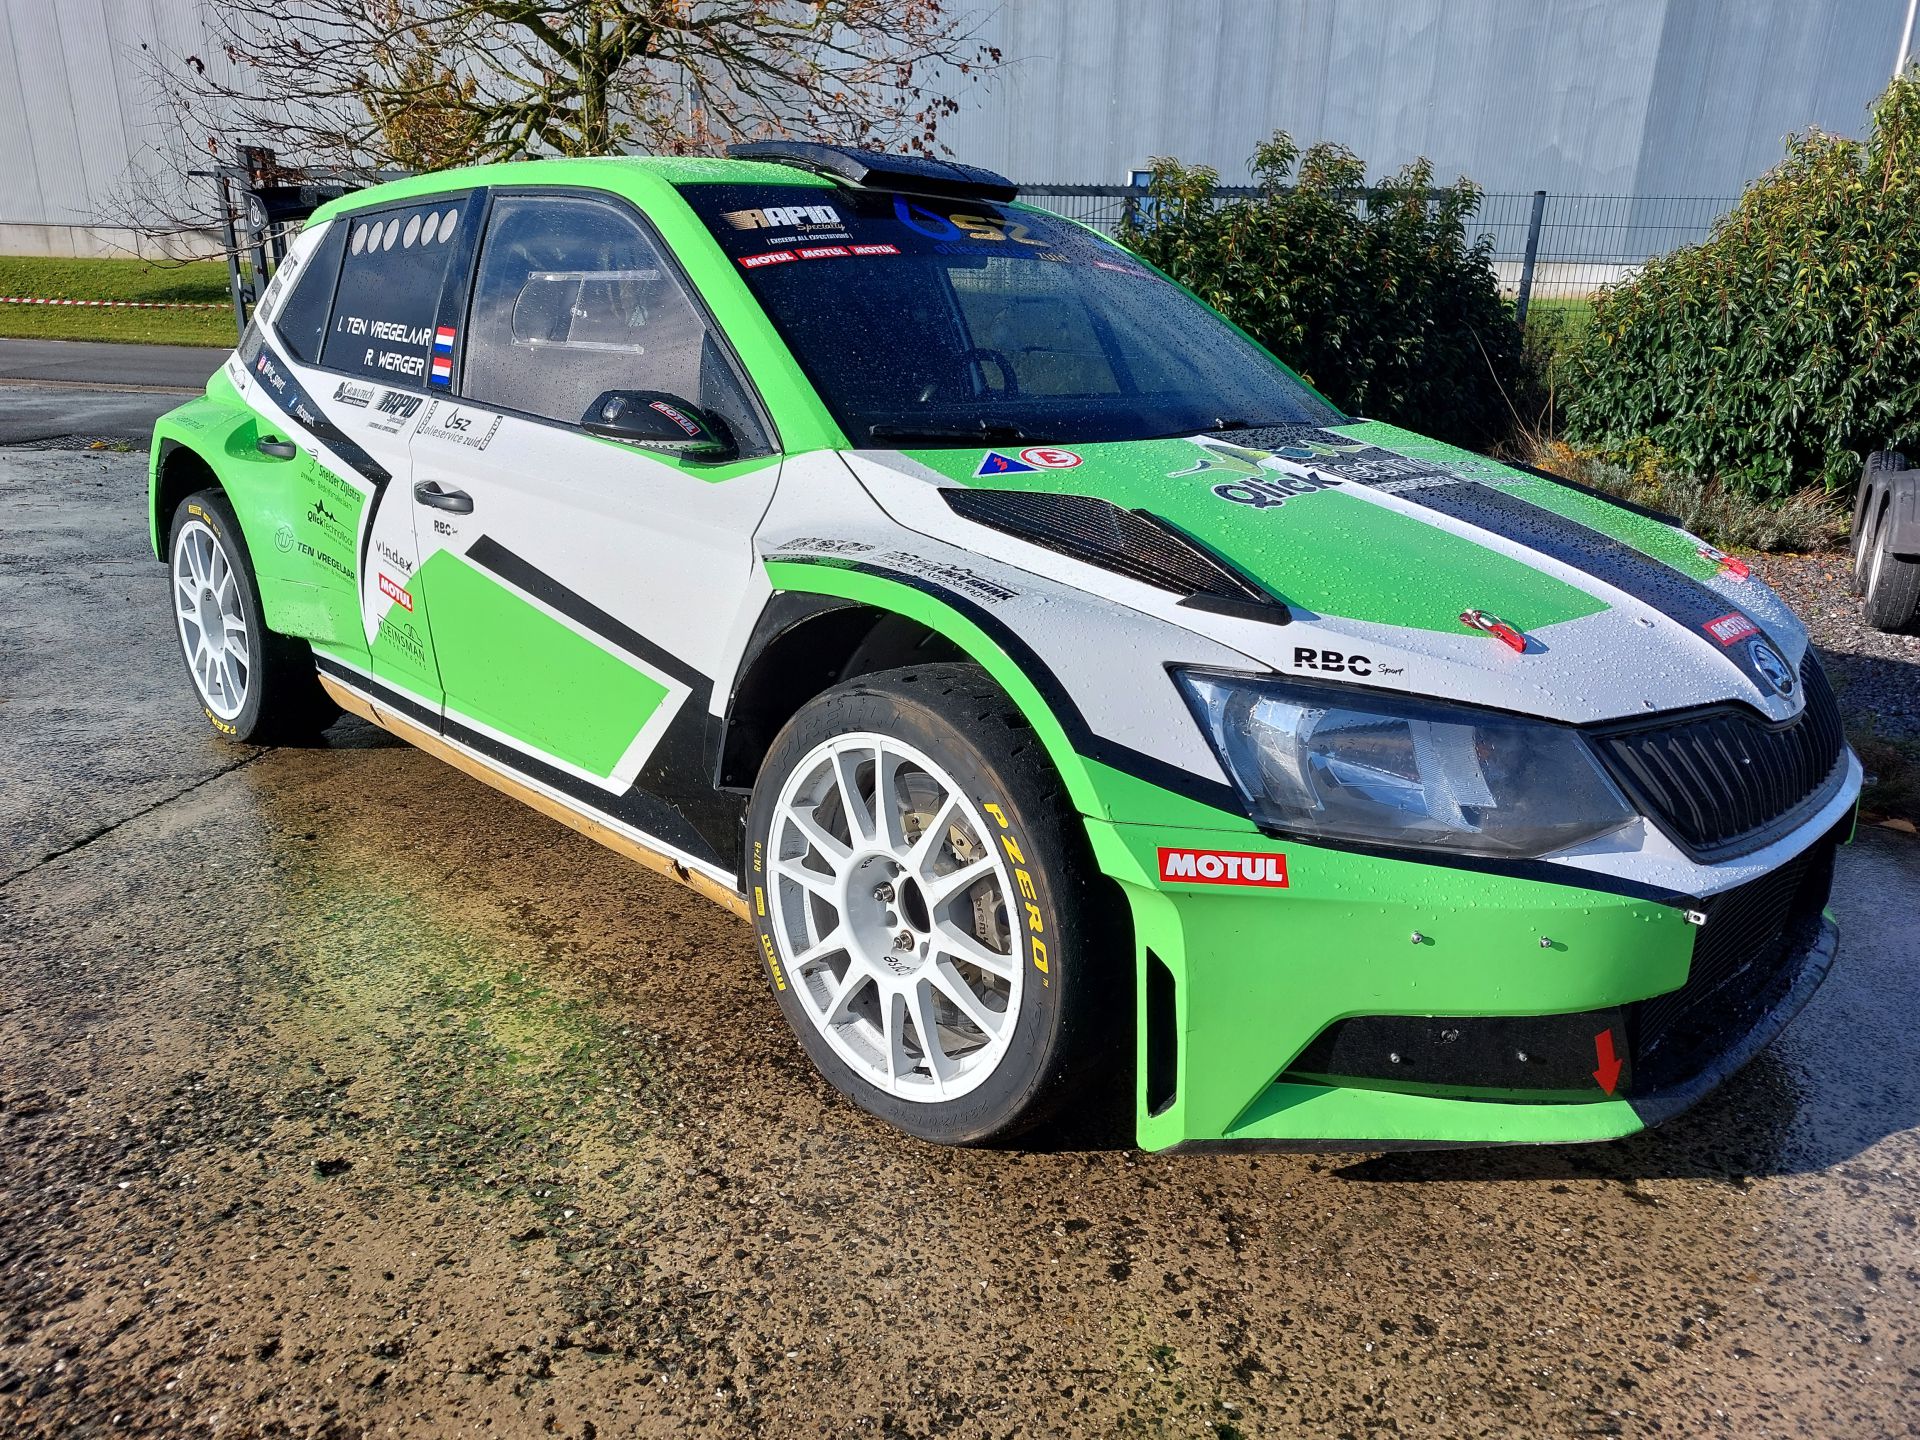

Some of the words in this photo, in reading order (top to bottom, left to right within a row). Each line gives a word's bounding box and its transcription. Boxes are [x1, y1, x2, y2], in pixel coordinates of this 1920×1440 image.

[722, 206, 841, 230] RAPID
[796, 222, 846, 233] Specialty
[746, 253, 794, 267] MOTUL
[801, 247, 847, 258] MOTUL
[854, 245, 897, 255] MOTUL
[347, 317, 368, 335] TEN
[370, 319, 432, 346] VREGELAAR
[364, 349, 373, 366] R.
[378, 351, 425, 377] WERGER
[375, 390, 423, 418] RAPID
[655, 402, 697, 433] MOTUL
[423, 425, 464, 443] olieservice
[463, 436, 483, 448] zuid
[319, 464, 340, 488] Snelder
[433, 519, 451, 536] RBC
[297, 541, 315, 557] TEN
[316, 550, 355, 580] VREGELAAR
[380, 577, 412, 610] MOTUL
[965, 577, 1016, 602] BRINK
[377, 617, 426, 663] KLEINSMAN
[1710, 615, 1752, 641] MOTU
[1294, 647, 1372, 677] RBC
[1377, 663, 1405, 677] Sport
[753, 841, 762, 873] RA7+B
[1165, 852, 1283, 882] MOTUL
[974, 897, 988, 942] brem
